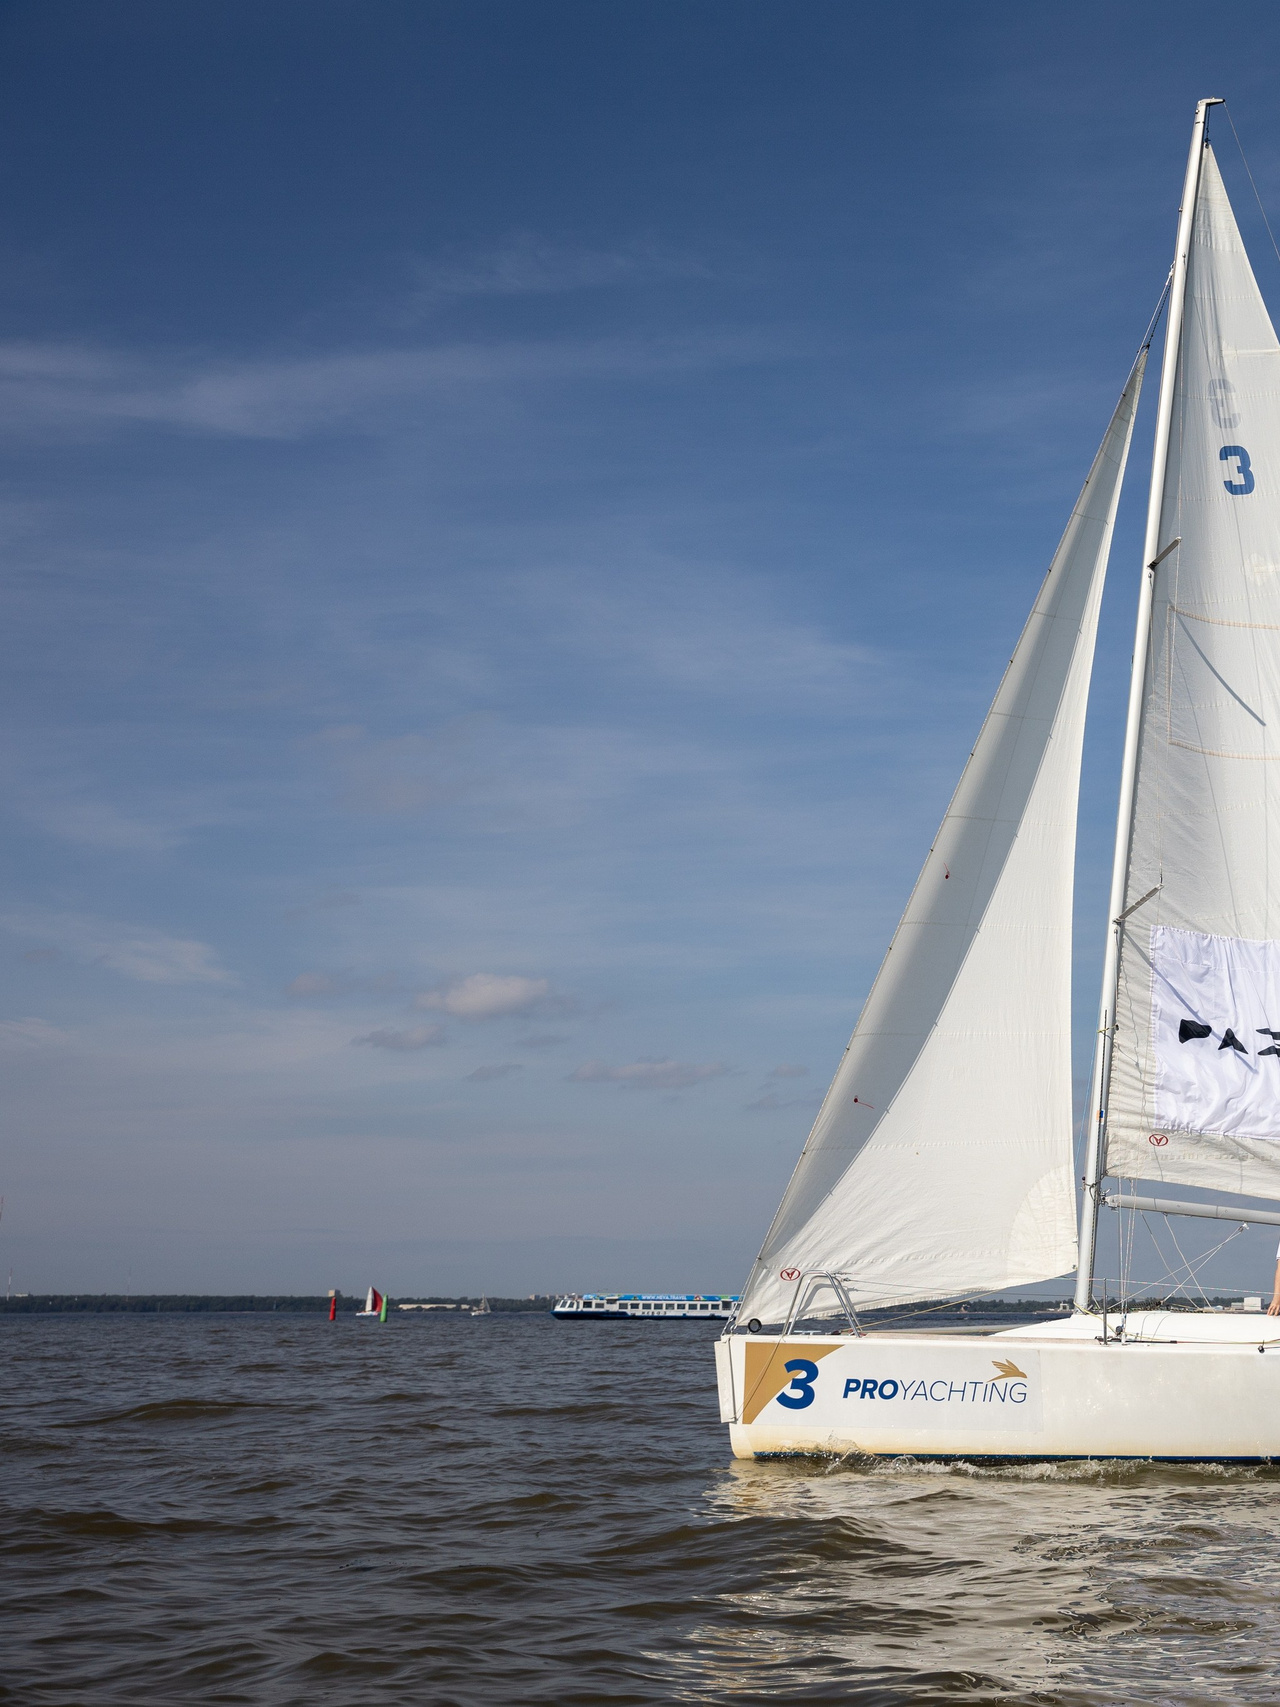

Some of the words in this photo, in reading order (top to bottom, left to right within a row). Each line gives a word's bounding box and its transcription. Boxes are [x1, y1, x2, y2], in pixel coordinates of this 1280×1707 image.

[1219, 445, 1255, 495] 3
[776, 1358, 819, 1410] 3
[842, 1377, 1028, 1403] PROYACHTING
